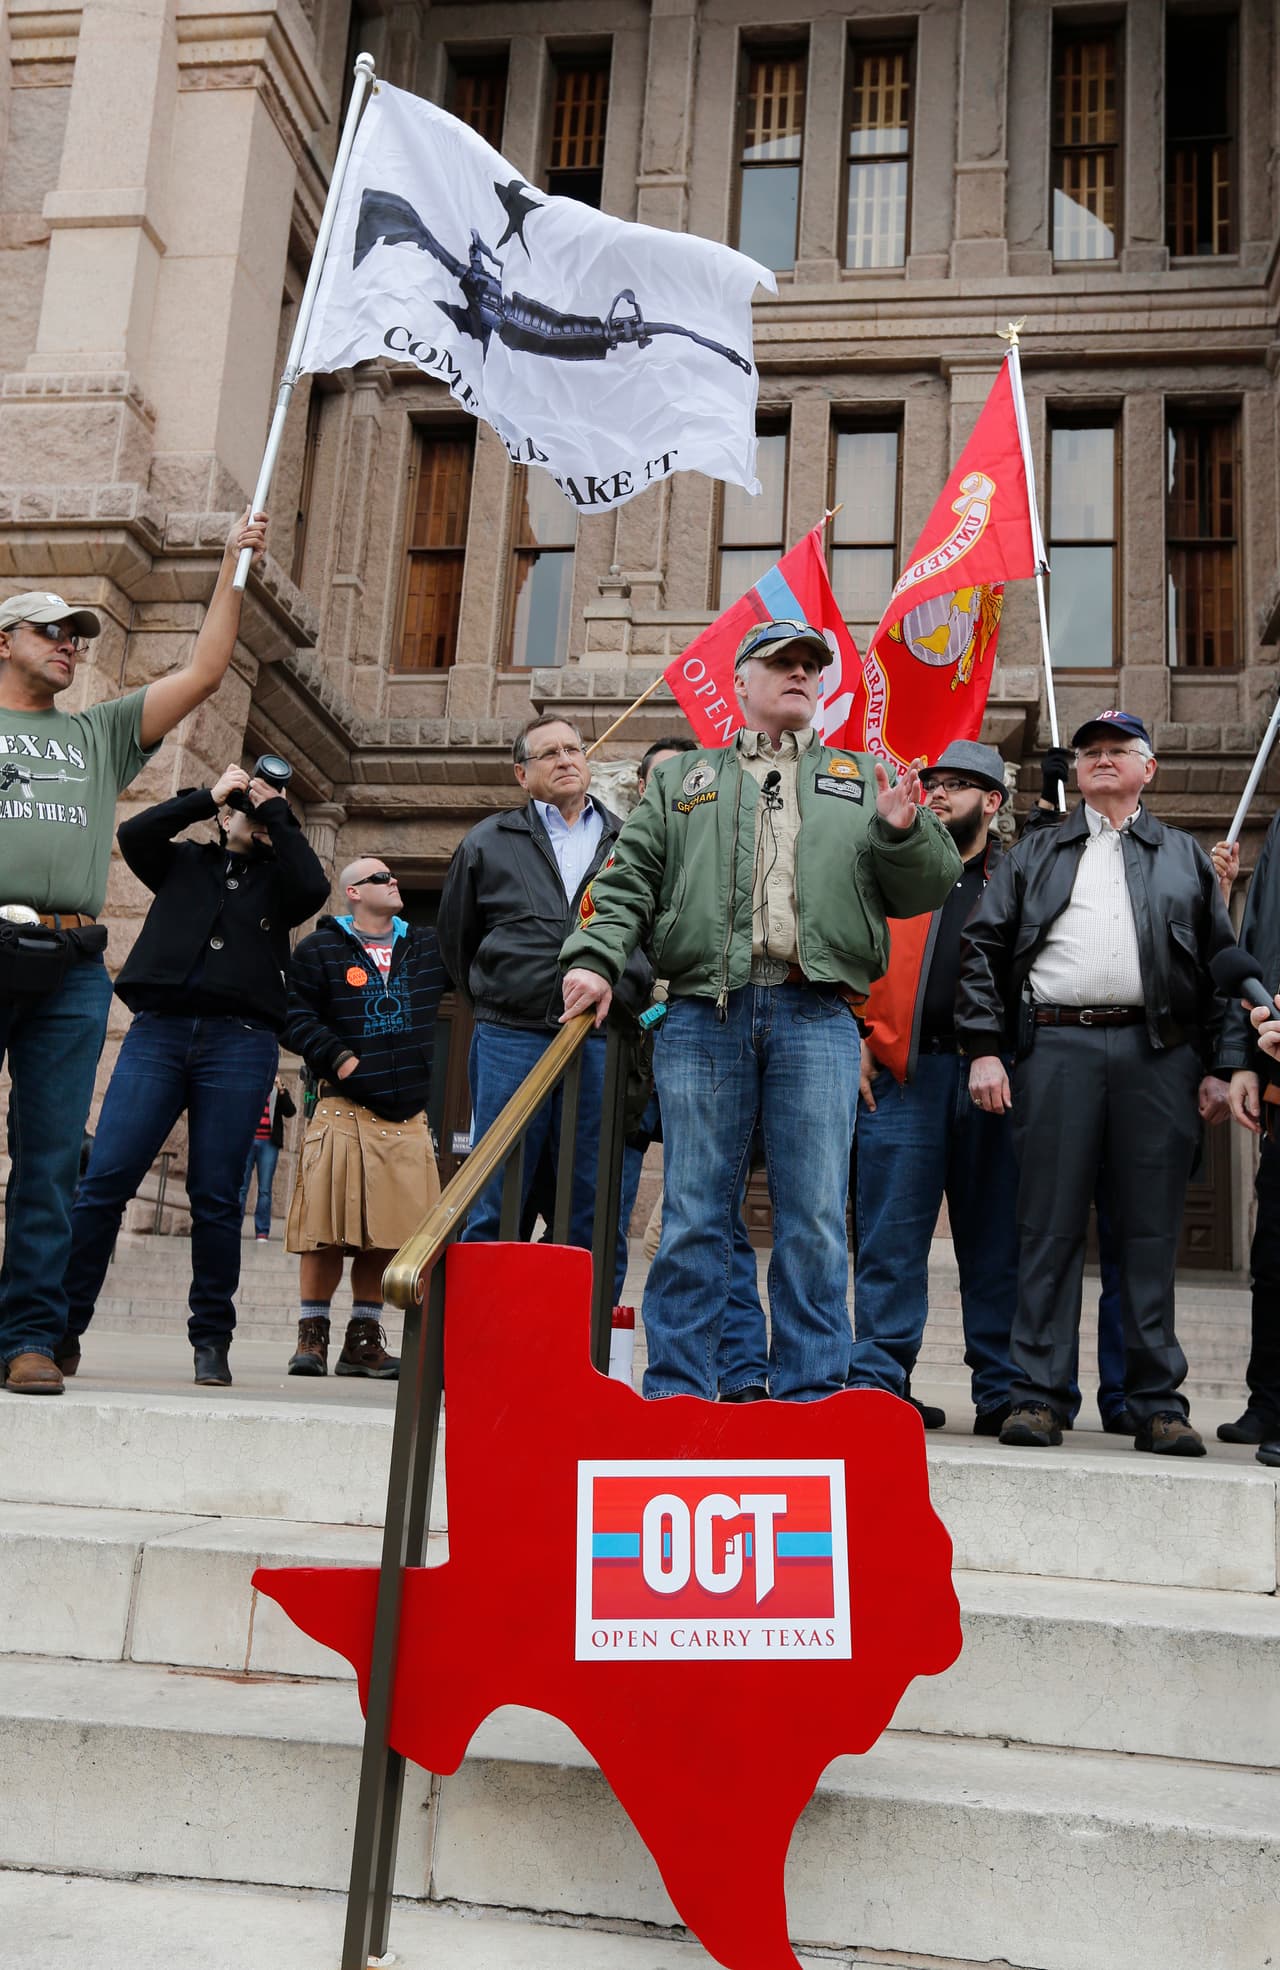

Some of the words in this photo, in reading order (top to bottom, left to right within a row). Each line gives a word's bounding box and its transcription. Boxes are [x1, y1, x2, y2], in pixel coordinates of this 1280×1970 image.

[683, 658, 741, 743] OPEN
[0, 734, 86, 770] EXAS
[36, 802, 66, 822] THE
[642, 1493, 787, 1605] OCT
[592, 1630, 657, 1647] OPEN
[670, 1629, 752, 1647] CARRY
[762, 1628, 835, 1647] TEXAS
